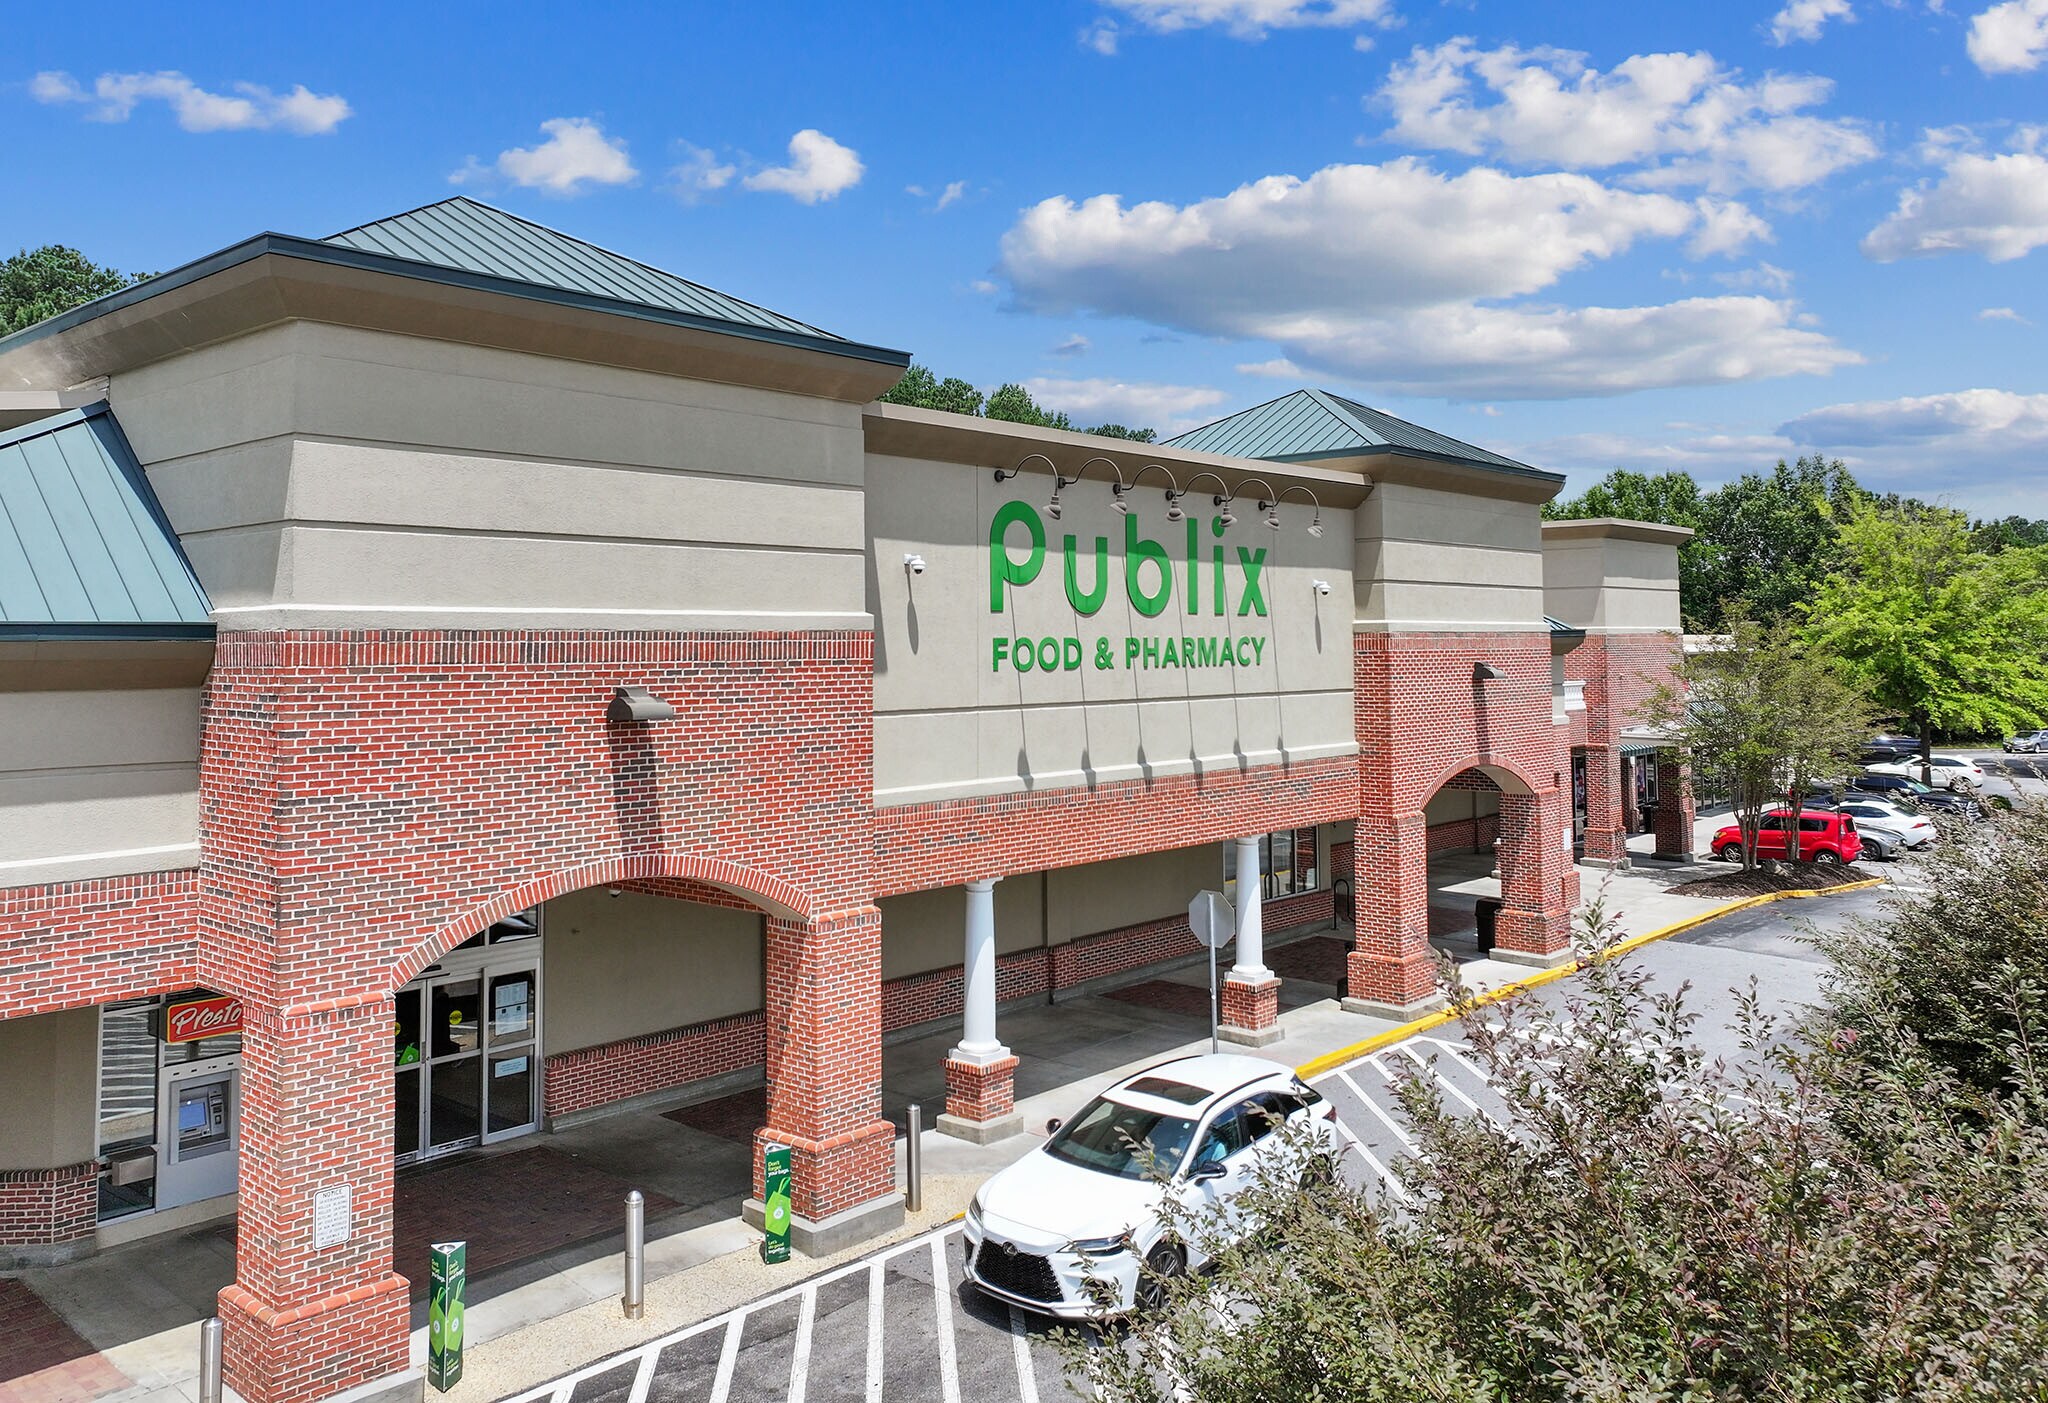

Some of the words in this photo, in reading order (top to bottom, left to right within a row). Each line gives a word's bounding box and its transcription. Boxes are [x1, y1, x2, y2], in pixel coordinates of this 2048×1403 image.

[989, 500, 1267, 617] Publix
[992, 636, 1082, 672] FOOD
[1094, 636, 1114, 670] &
[1125, 635, 1266, 670] PHARMACY
[171, 1001, 242, 1035] Presto
[322, 1189, 343, 1198] NOTICE
